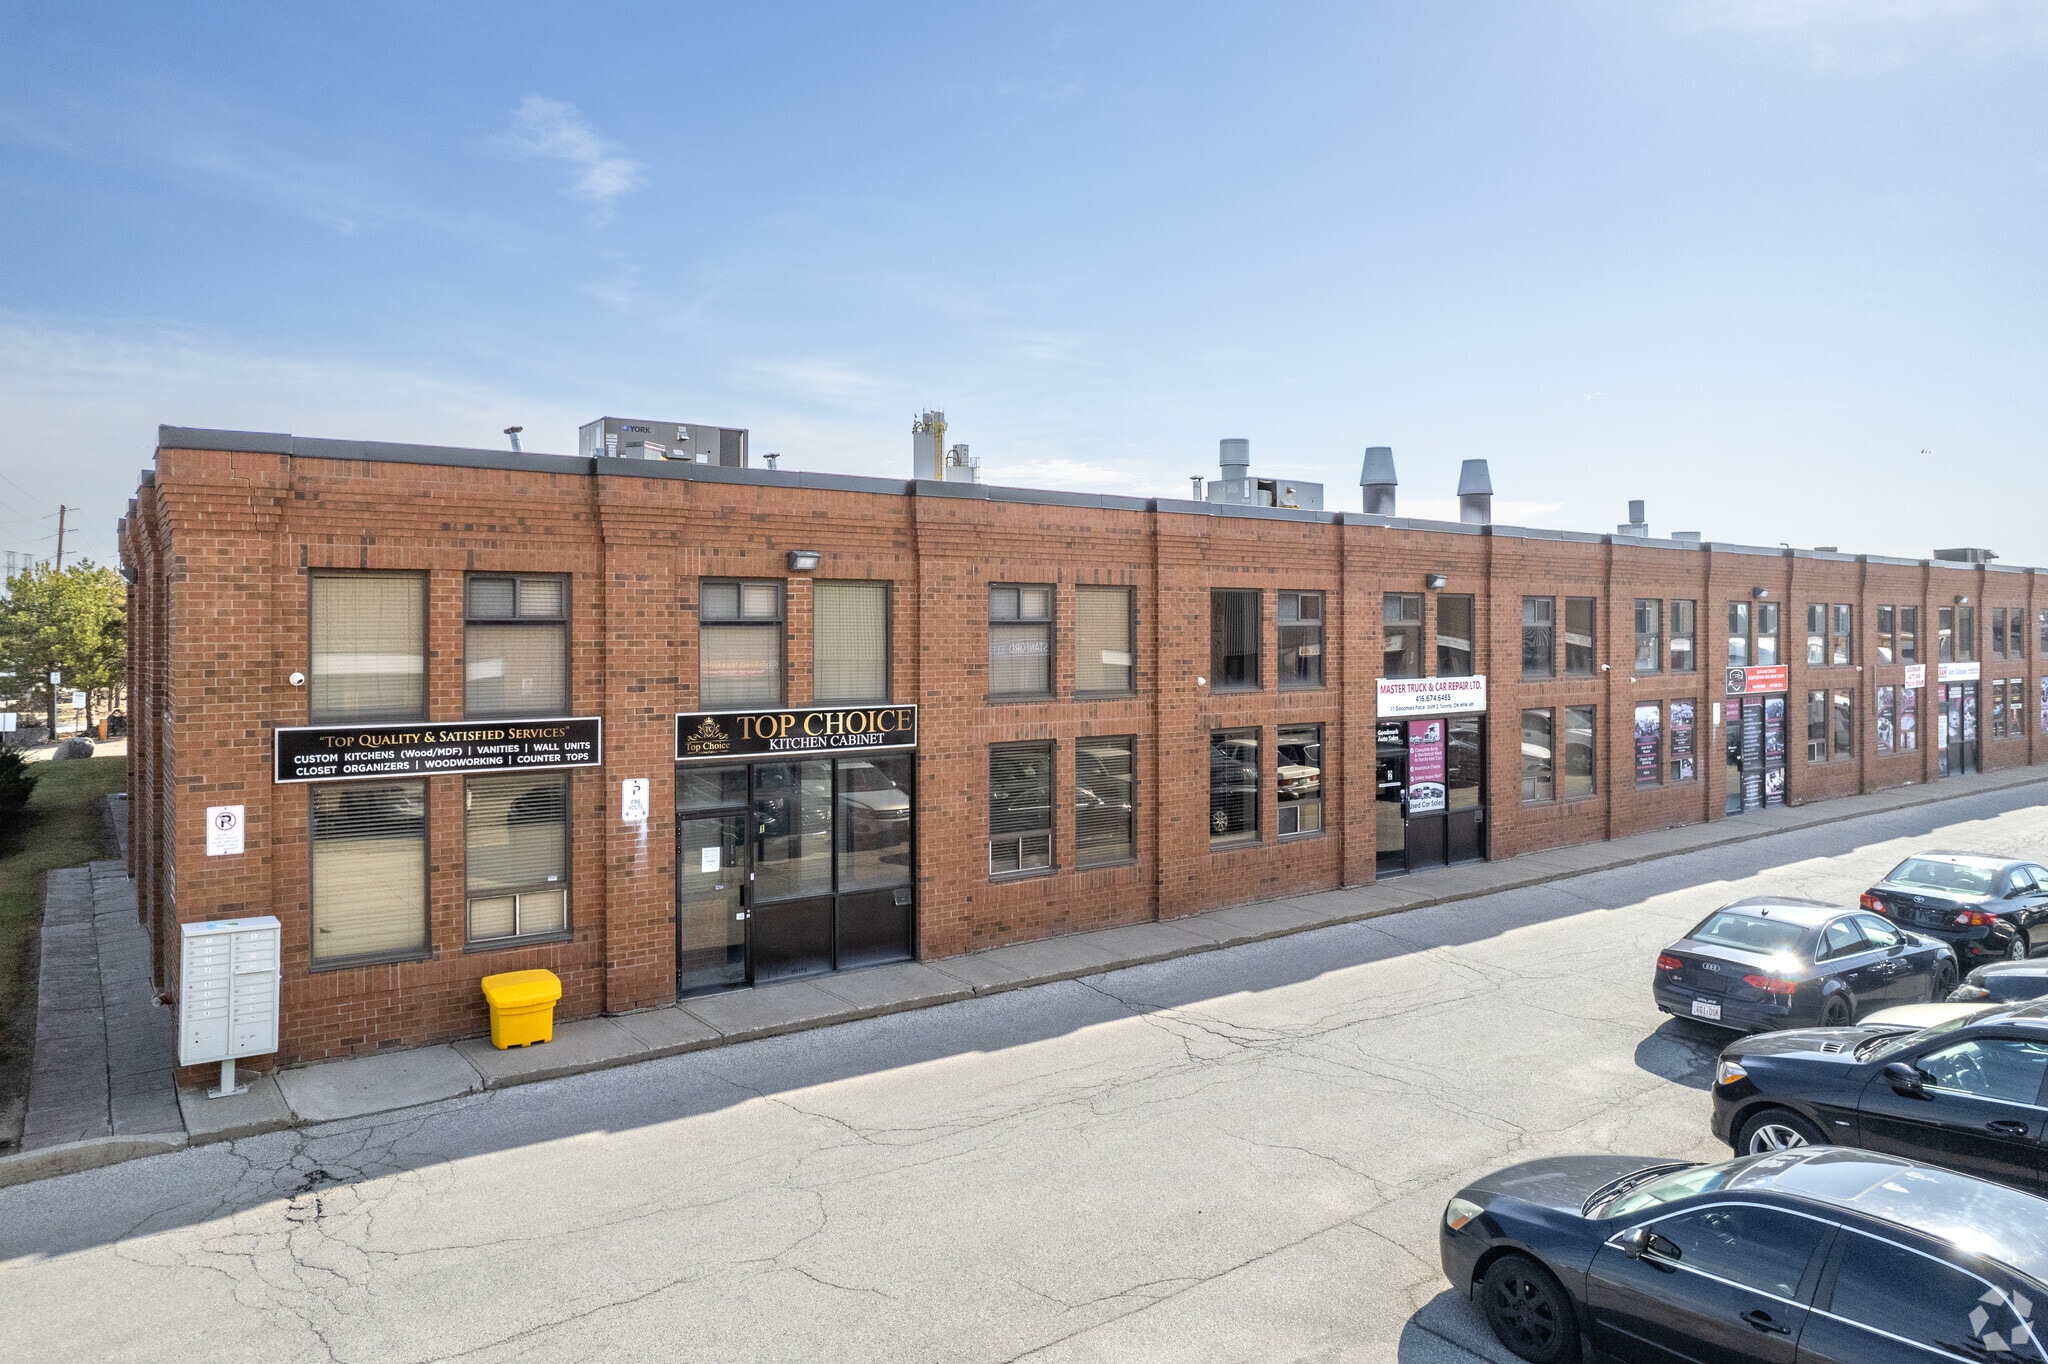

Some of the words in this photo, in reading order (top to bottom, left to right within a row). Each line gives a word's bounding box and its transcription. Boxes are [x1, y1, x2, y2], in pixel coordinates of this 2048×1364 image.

[630, 425, 651, 434] YORK
[1380, 684, 1406, 694] MASTER
[1407, 683, 1427, 693] TRUCK
[1428, 683, 1434, 692] &
[1435, 682, 1447, 691] CAR
[1448, 681, 1469, 691] REPAIR
[1470, 680, 1482, 690] LTD.
[736, 714, 796, 739] TOP
[803, 709, 913, 736] CHOICE
[358, 733, 421, 748] QUALITY
[424, 731, 435, 743] &
[439, 729, 505, 742] SATISFIED
[685, 743, 701, 752] Top
[702, 741, 730, 750] Choice
[769, 736, 827, 750] KITCHEN
[830, 733, 884, 747] CABINET
[294, 753, 338, 764] CUSTOM
[344, 751, 395, 761] KITCHENS
[401, 747, 463, 759] (Wood/MDF)
[477, 744, 520, 754] VANITIES
[533, 743, 559, 751] WALL
[565, 741, 591, 750] UNITS
[296, 765, 337, 776] CLOSET
[343, 761, 410, 773] ORGANIZERS
[425, 756, 503, 768] WOODWORKING
[517, 754, 561, 763] COUNTER
[566, 752, 589, 761] TOPS
